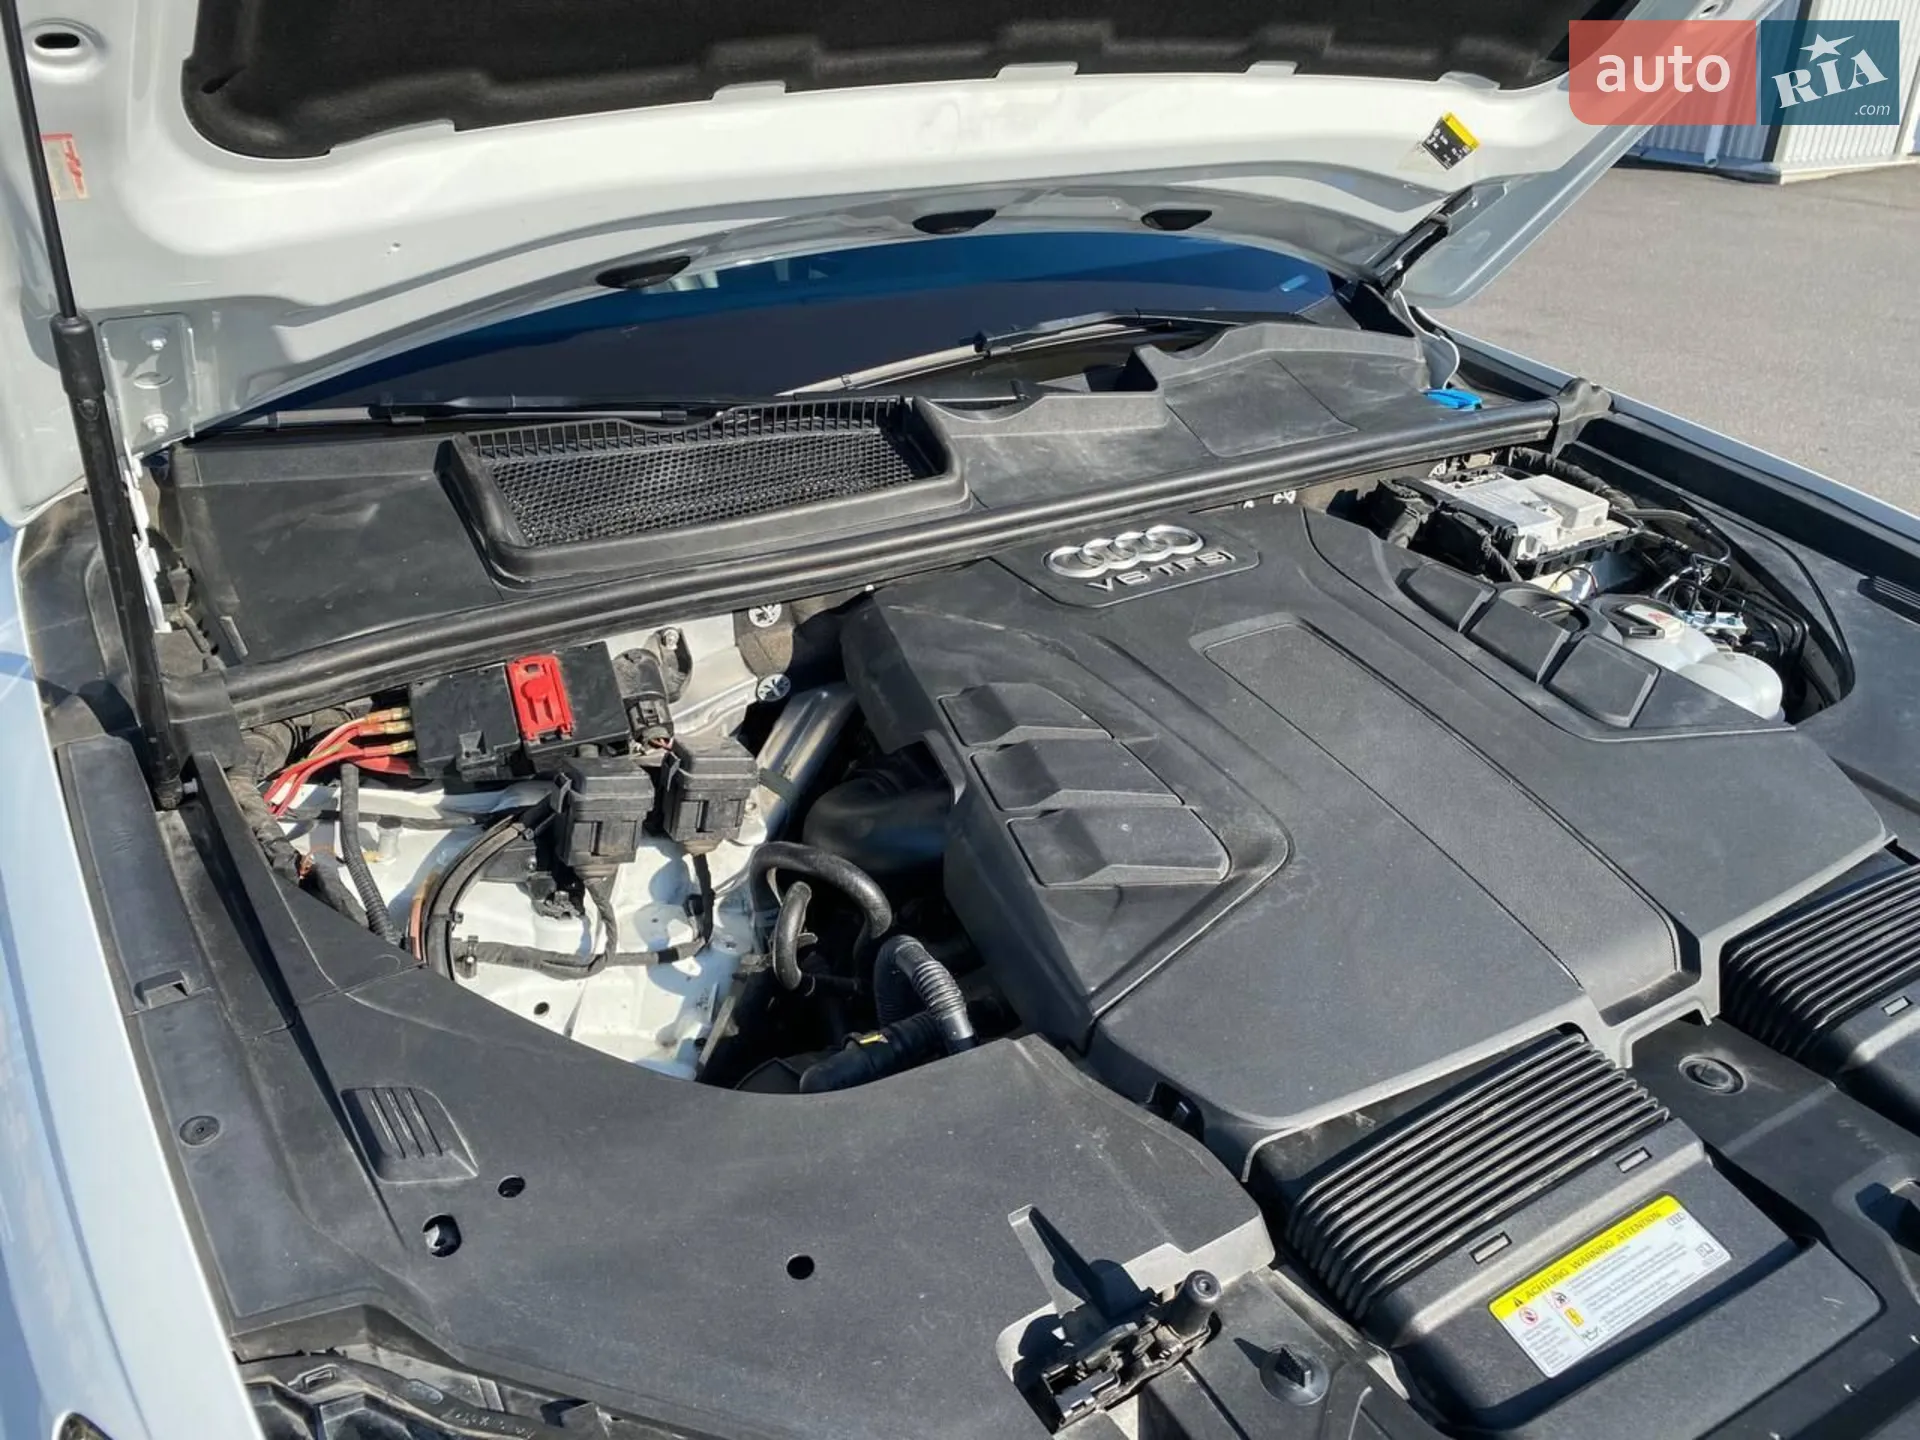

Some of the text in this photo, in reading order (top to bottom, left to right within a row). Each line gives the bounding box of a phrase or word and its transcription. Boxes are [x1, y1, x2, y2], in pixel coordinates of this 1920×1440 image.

[1526, 1268, 1569, 1302] ACHTUNG
[1570, 1239, 1614, 1269] WARNING
[1616, 1211, 1661, 1242] ATTENTION
